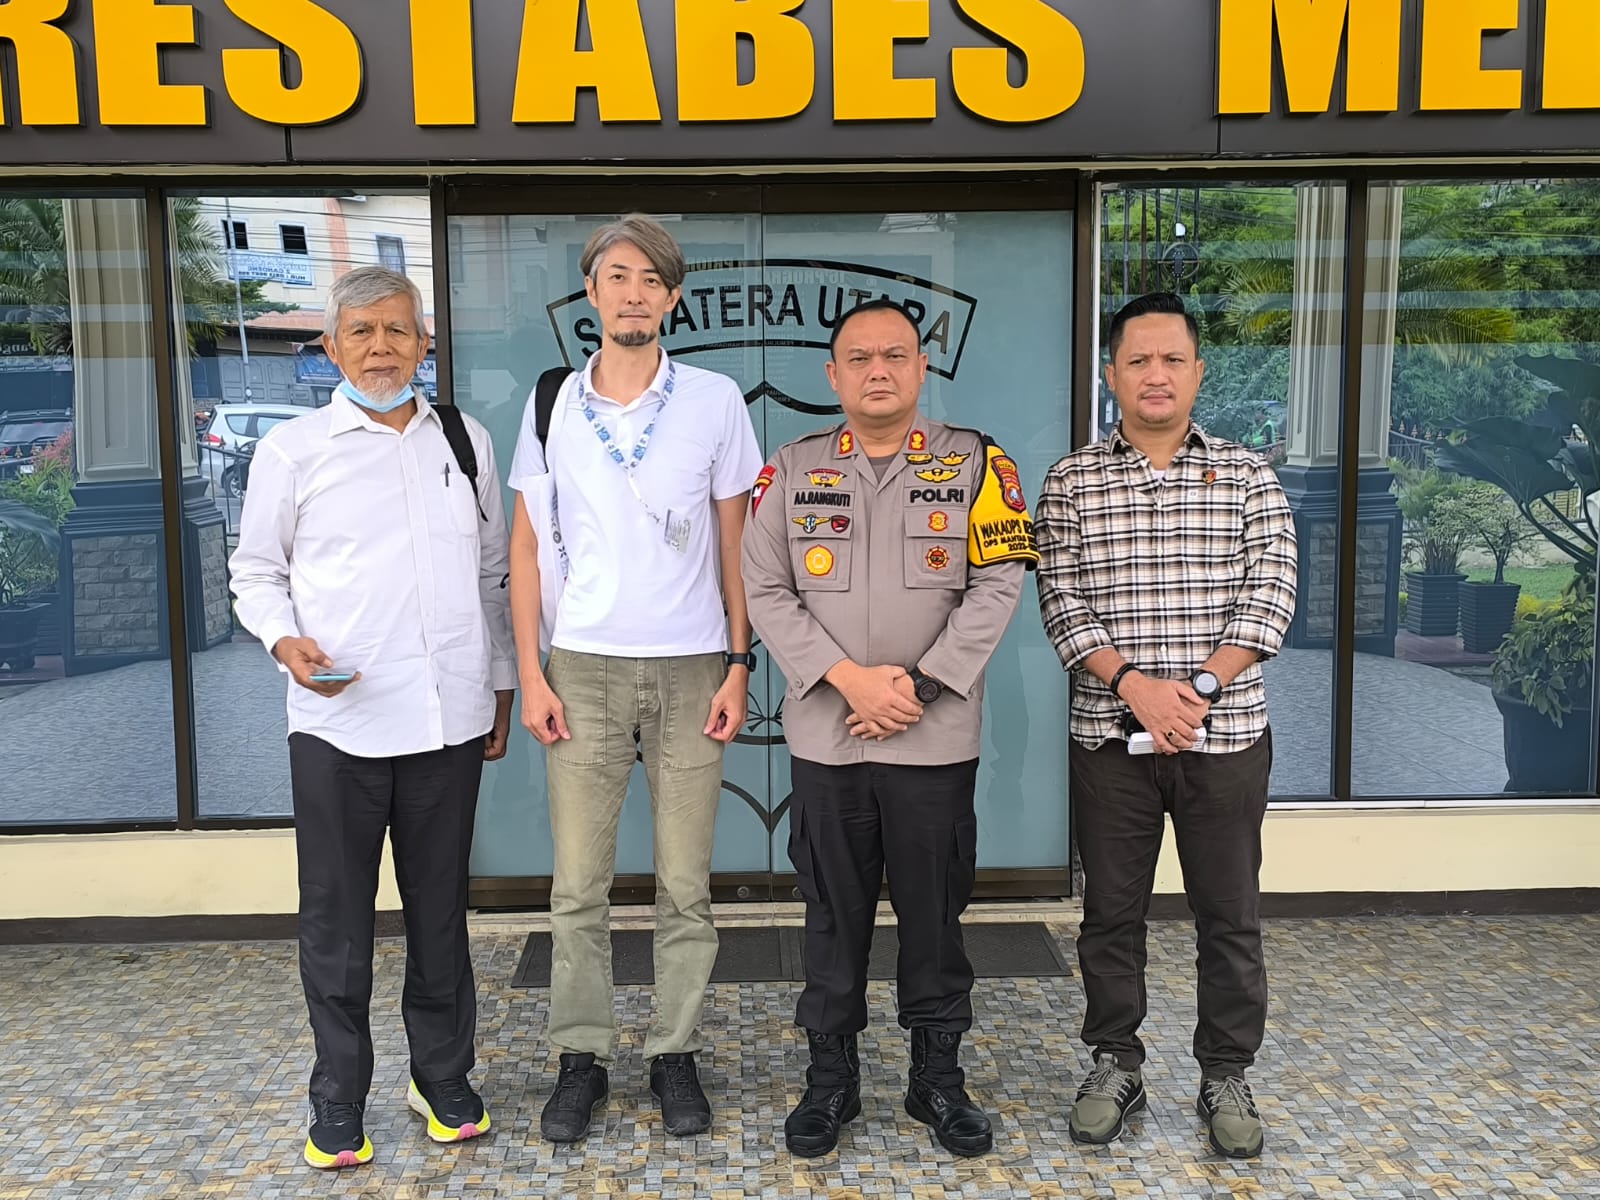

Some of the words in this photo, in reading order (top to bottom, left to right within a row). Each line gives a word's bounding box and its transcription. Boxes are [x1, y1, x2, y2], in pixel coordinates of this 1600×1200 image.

[574, 284, 805, 359] SATERA
[818, 285, 950, 355] UTRA
[910, 488, 964, 503] POLRI
